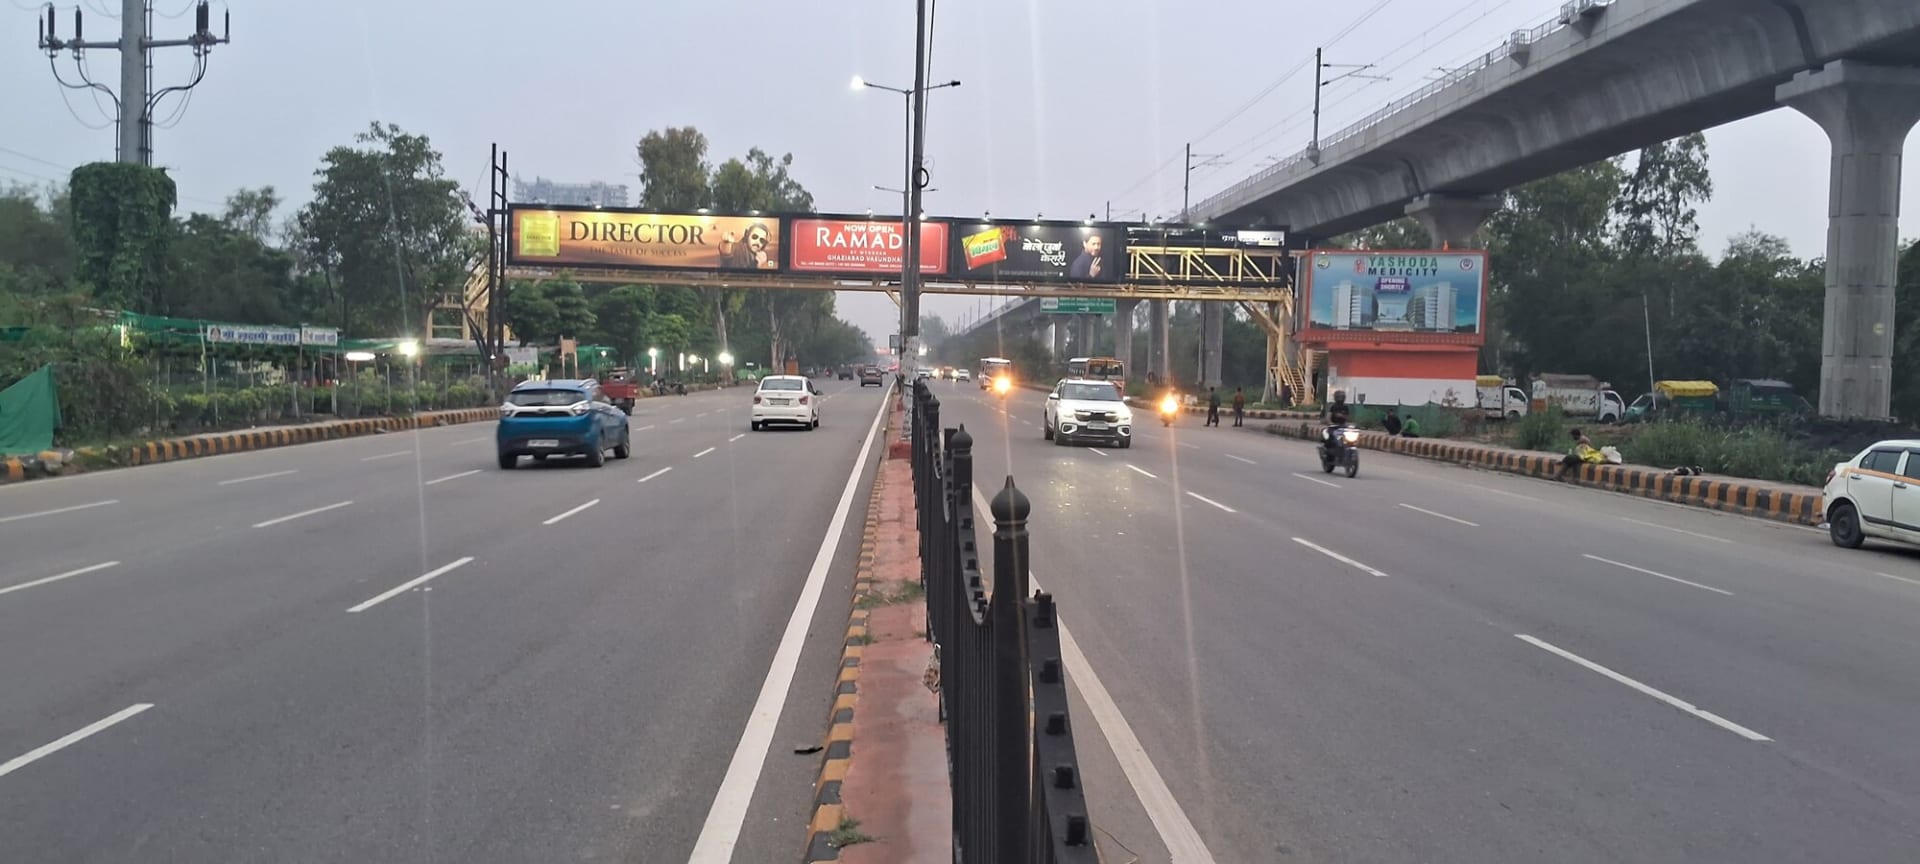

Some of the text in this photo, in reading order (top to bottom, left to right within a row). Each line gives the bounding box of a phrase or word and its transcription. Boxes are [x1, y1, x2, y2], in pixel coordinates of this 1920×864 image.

[568, 220, 706, 245] DIRECTOR
[844, 224, 895, 233] NOW OPEN
[816, 226, 903, 249] RAMAD
[590, 246, 687, 257] THE TASTE OF SUCCESS
[827, 254, 903, 263] GHAZIABAD VASUNDHA
[1369, 256, 1438, 267] YASHODA
[1368, 267, 1438, 276] MEDICITY
